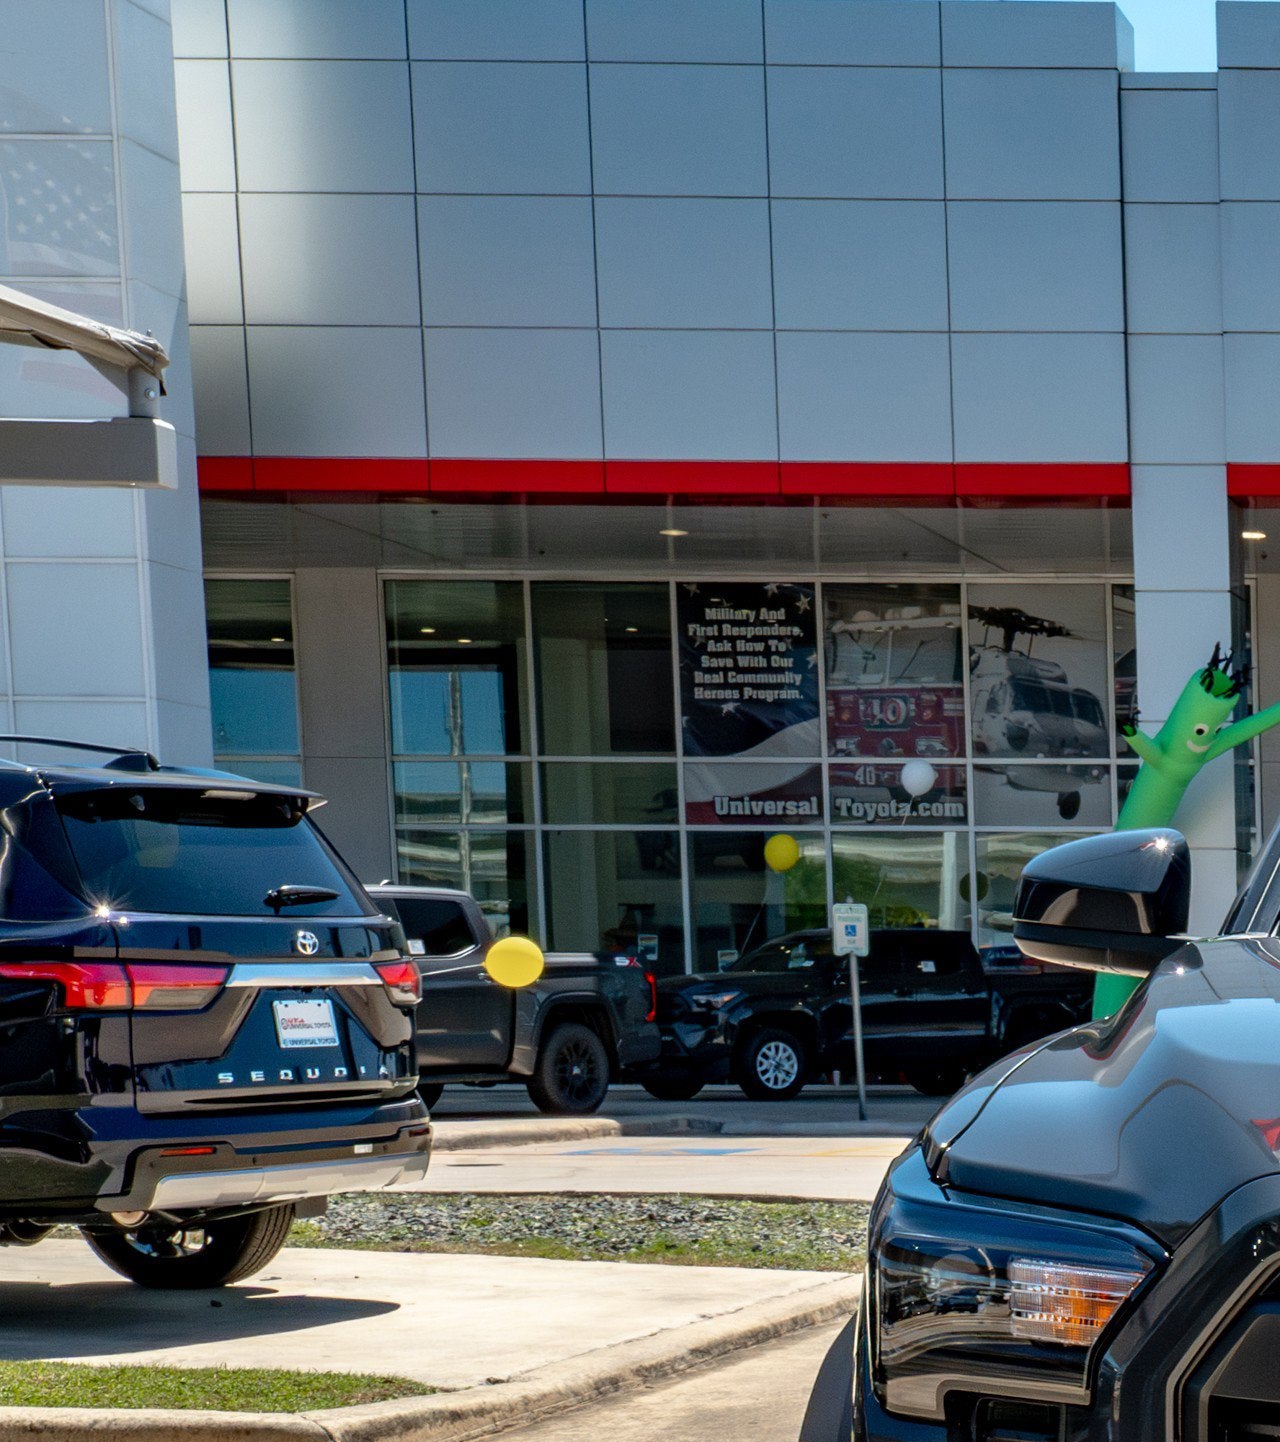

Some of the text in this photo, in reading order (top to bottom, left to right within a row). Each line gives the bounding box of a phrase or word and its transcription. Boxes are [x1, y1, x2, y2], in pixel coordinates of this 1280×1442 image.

[705, 608, 785, 622] Military And
[688, 624, 804, 638] First Responders,
[707, 640, 786, 652] Ask How To
[701, 655, 794, 667] Save With Our
[694, 671, 802, 685] Real Community
[694, 687, 804, 702] Heroes Program.
[860, 697, 907, 725] 40
[855, 765, 876, 785] 40
[714, 796, 965, 822] Universal Toyota.com
[218, 1065, 389, 1083] SEQUOIA
